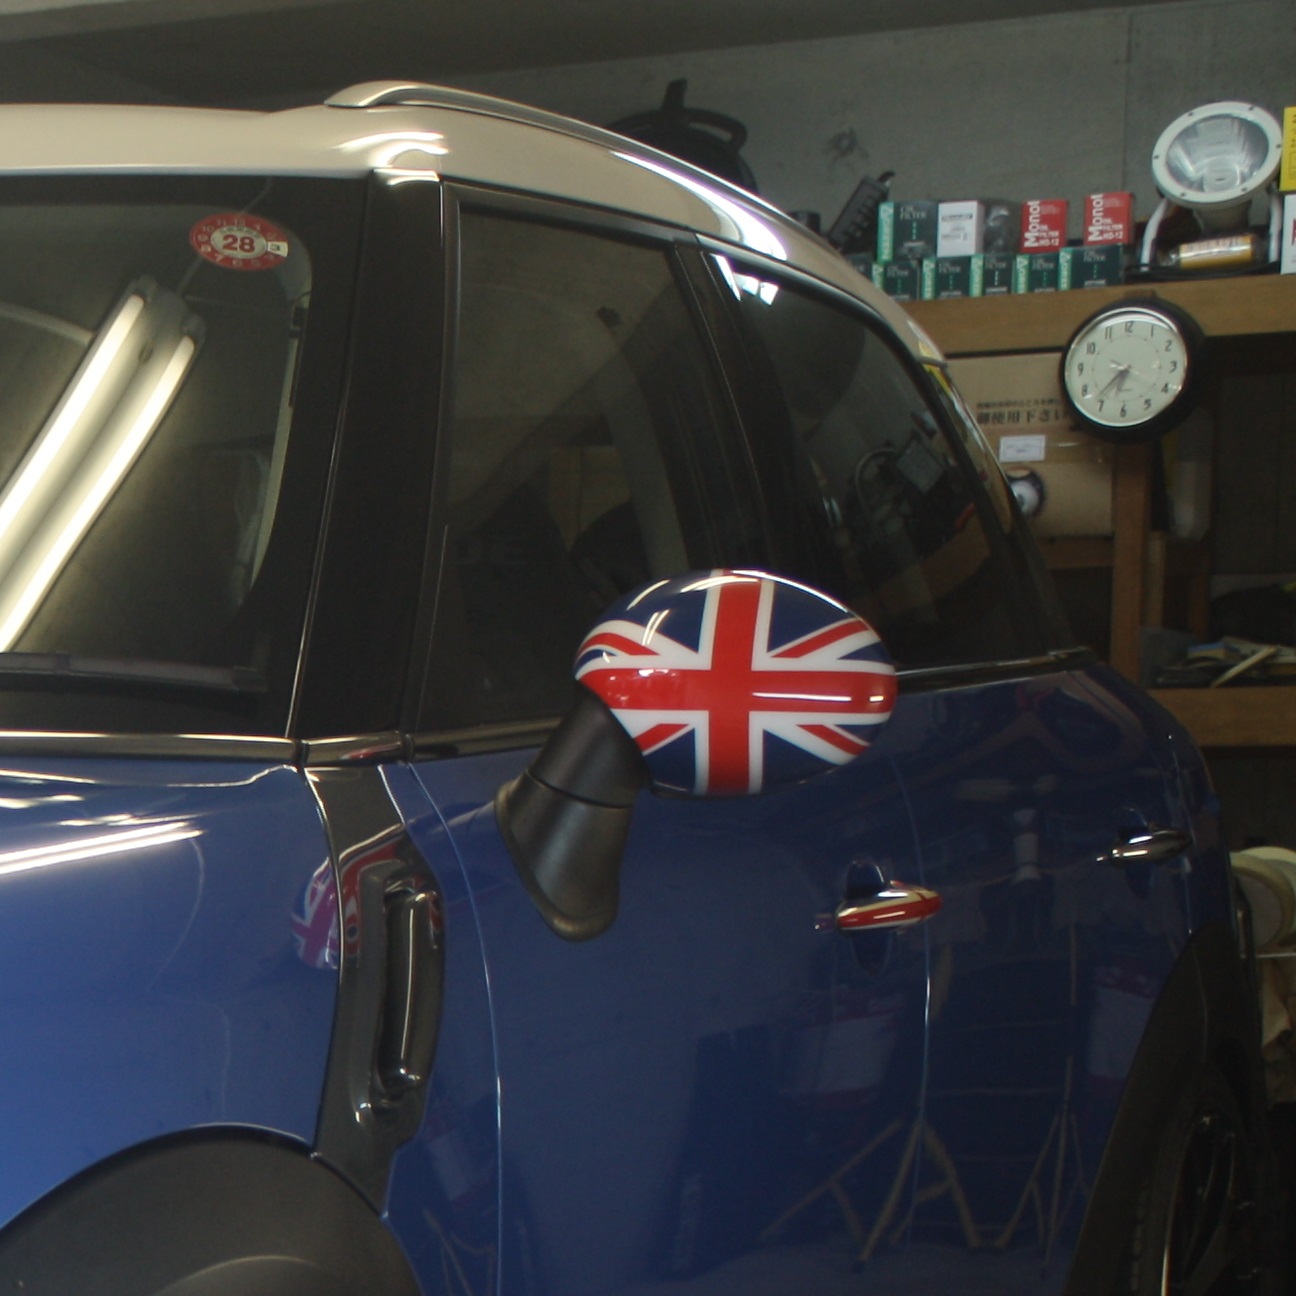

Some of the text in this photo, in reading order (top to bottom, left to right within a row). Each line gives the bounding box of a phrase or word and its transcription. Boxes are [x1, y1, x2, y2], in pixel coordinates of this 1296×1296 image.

[222, 234, 256, 254] 28
[1125, 320, 1135, 333] 12
[1150, 325, 1155, 338] 1
[1105, 327, 1113, 340] 11
[1087, 342, 1096, 355] 10
[1165, 340, 1172, 352] 2
[1077, 363, 1084, 376] 9
[1169, 361, 1177, 373] 3
[1081, 384, 1088, 397] 8
[1161, 382, 1169, 394] 4
[1097, 400, 1104, 412] 7
[1120, 403, 1127, 417] 6
[1144, 399, 1152, 411] 5
